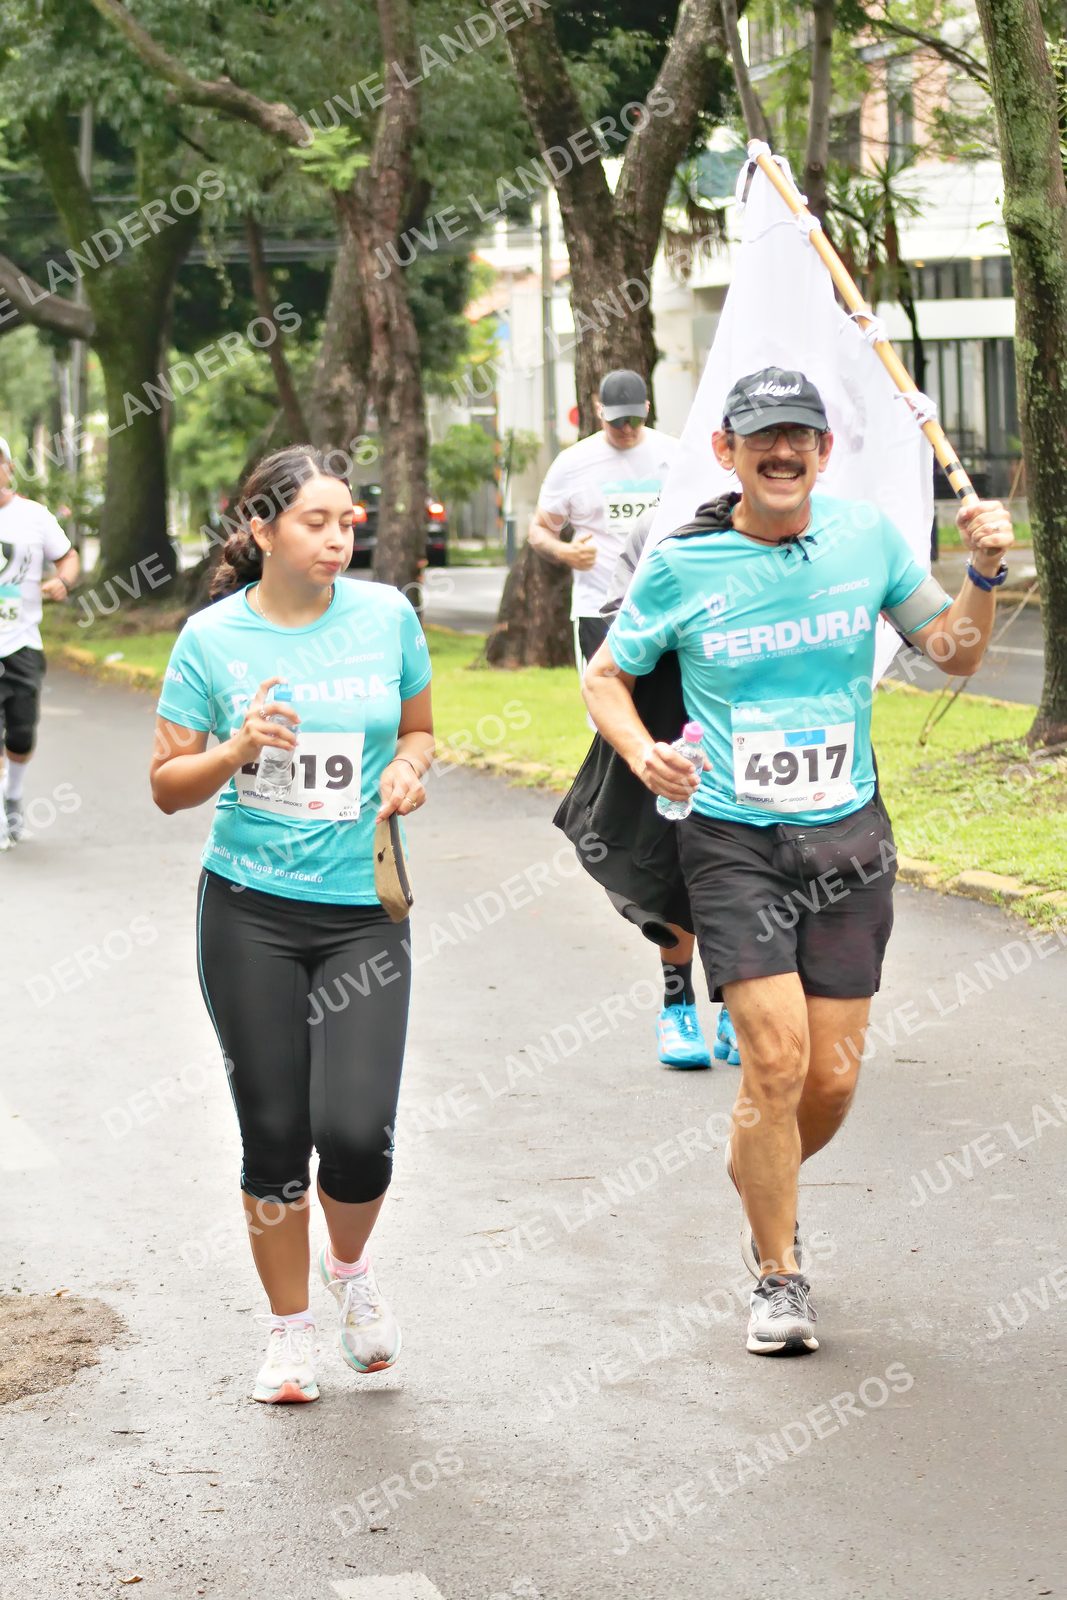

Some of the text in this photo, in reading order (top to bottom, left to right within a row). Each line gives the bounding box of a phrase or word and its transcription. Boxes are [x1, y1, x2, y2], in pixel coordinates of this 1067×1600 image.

[828, 578, 870, 596] BROOKS
[702, 605, 872, 660] PERDURA
[231, 674, 391, 714] PDURA
[744, 743, 847, 787] 4917
[274, 868, 324, 883] corriendo
